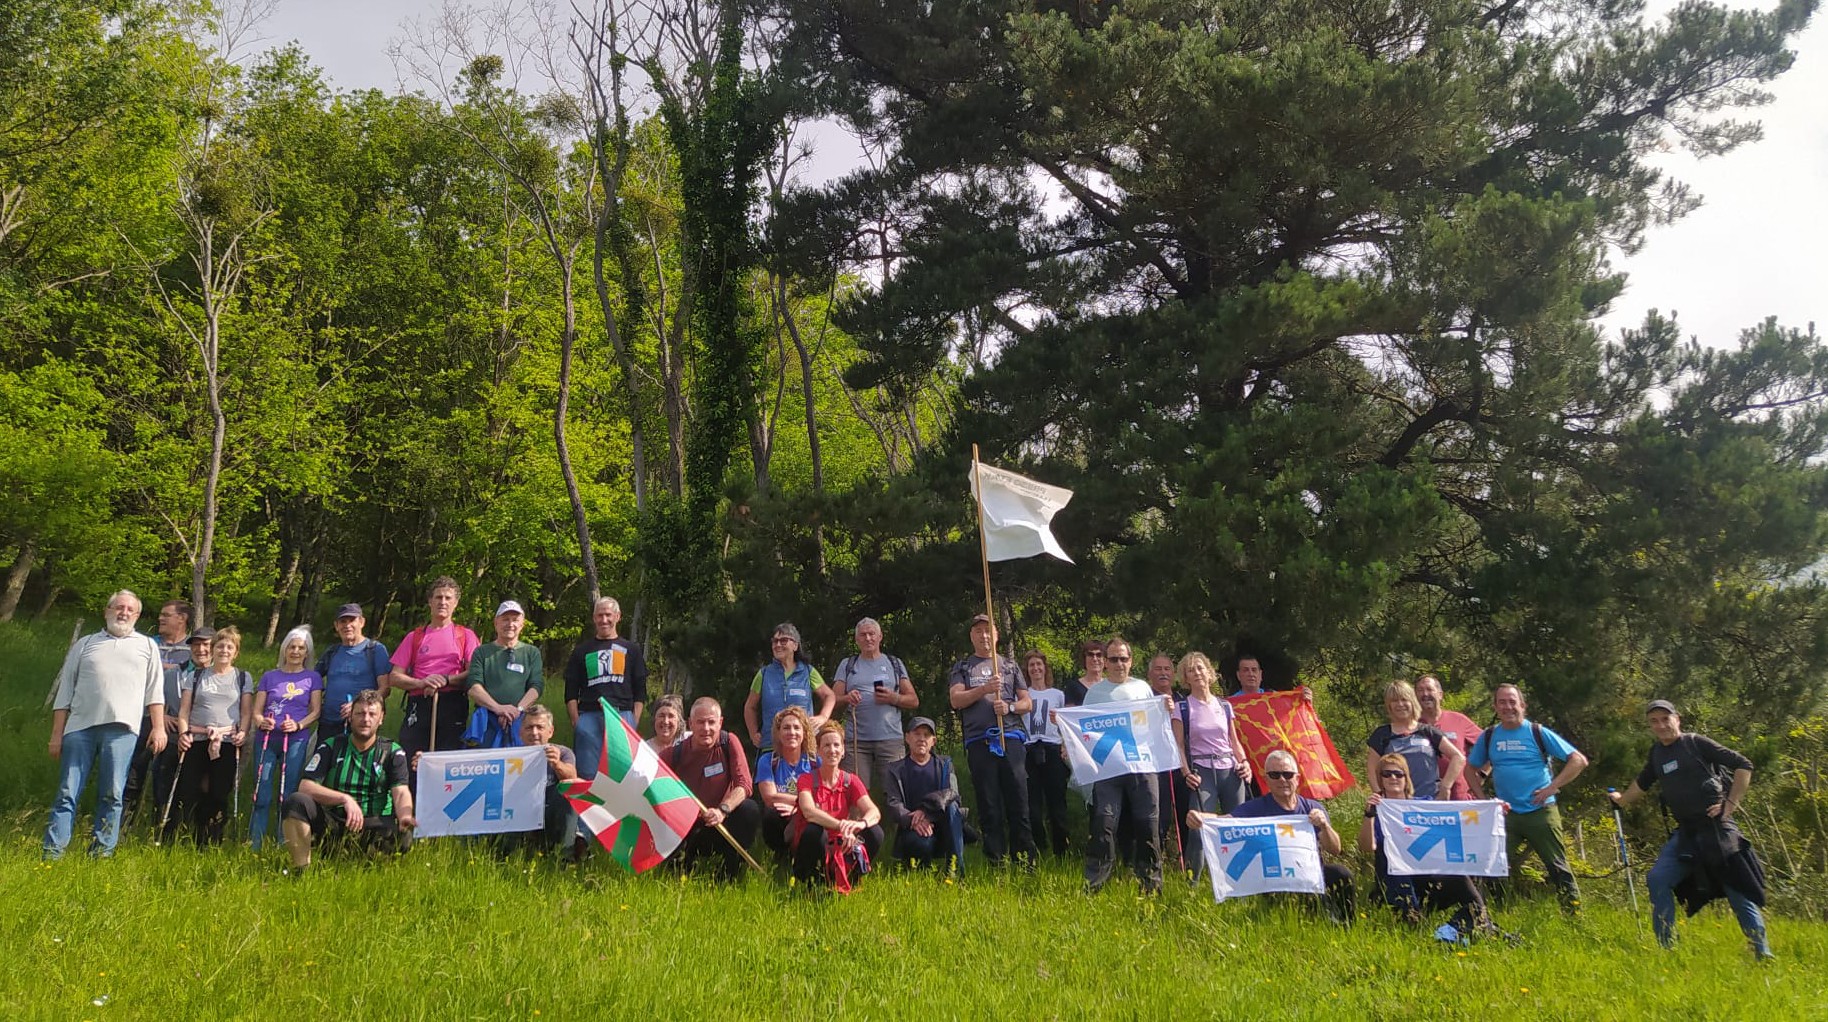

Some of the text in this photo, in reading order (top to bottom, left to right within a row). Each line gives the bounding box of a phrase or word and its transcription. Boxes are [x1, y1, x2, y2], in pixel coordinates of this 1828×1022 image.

[1084, 715, 1127, 730] etxera
[450, 763, 500, 777] etxera
[1408, 813, 1457, 826] etxera
[1223, 825, 1271, 841] etxera
